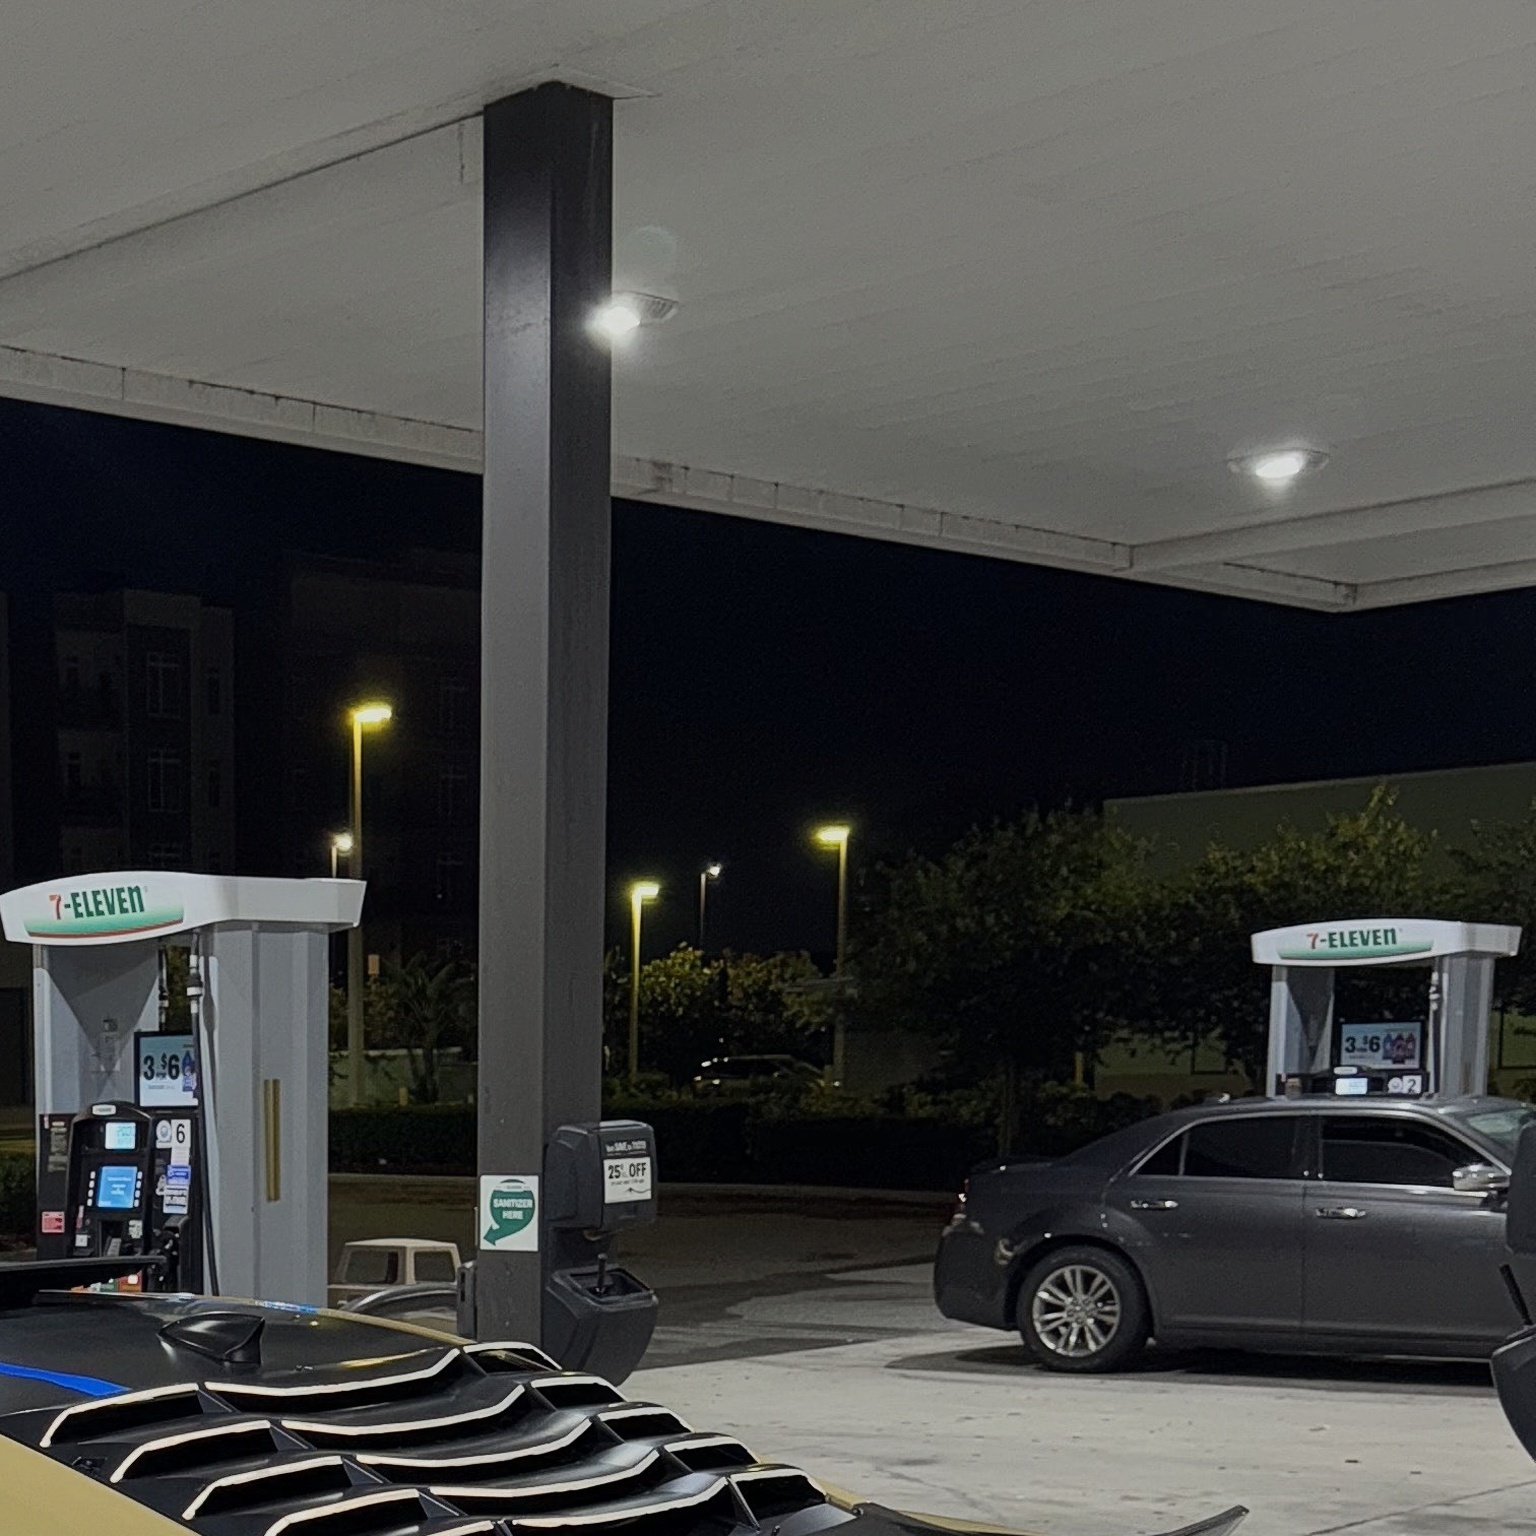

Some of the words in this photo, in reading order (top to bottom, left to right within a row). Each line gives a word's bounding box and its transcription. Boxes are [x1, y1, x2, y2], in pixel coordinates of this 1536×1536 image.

[1345, 1036, 1356, 1053] 3
[143, 1054, 155, 1080] 3
[1407, 1078, 1417, 1093] 2
[176, 1123, 185, 1143] 6
[629, 1162, 646, 1177] OFF
[493, 1198, 533, 1208] SANITIZER
